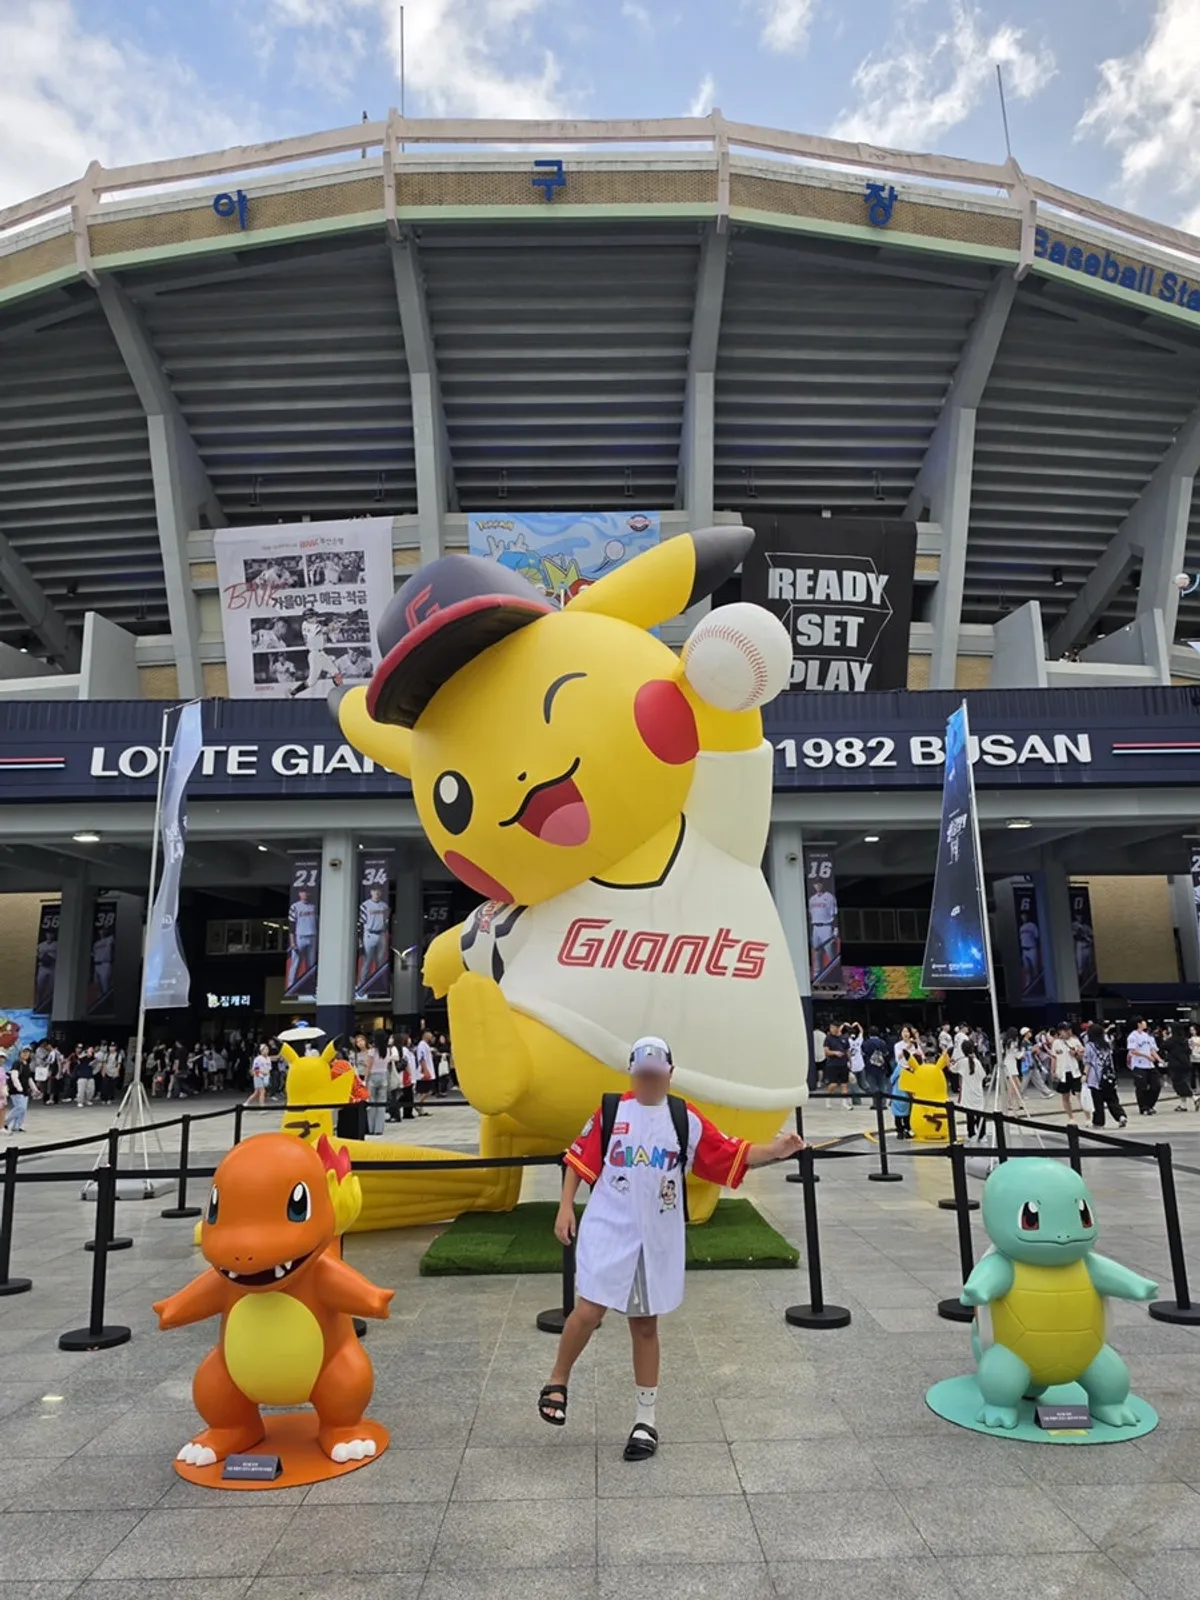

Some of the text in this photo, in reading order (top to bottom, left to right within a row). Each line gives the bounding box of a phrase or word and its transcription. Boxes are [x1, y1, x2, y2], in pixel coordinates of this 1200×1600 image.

[532, 160, 566, 202] 구
[864, 182, 898, 227] 장
[1034, 226, 1154, 296] Baseball
[768, 568, 889, 605] READY
[796, 613, 864, 647] SET
[775, 738, 897, 768] 1982
[293, 869, 318, 887] 21
[362, 868, 388, 886] 34
[808, 861, 832, 878] 16
[428, 907, 449, 920] 55
[557, 917, 769, 979] Giants
[609, 1139, 680, 1171] GIANT
